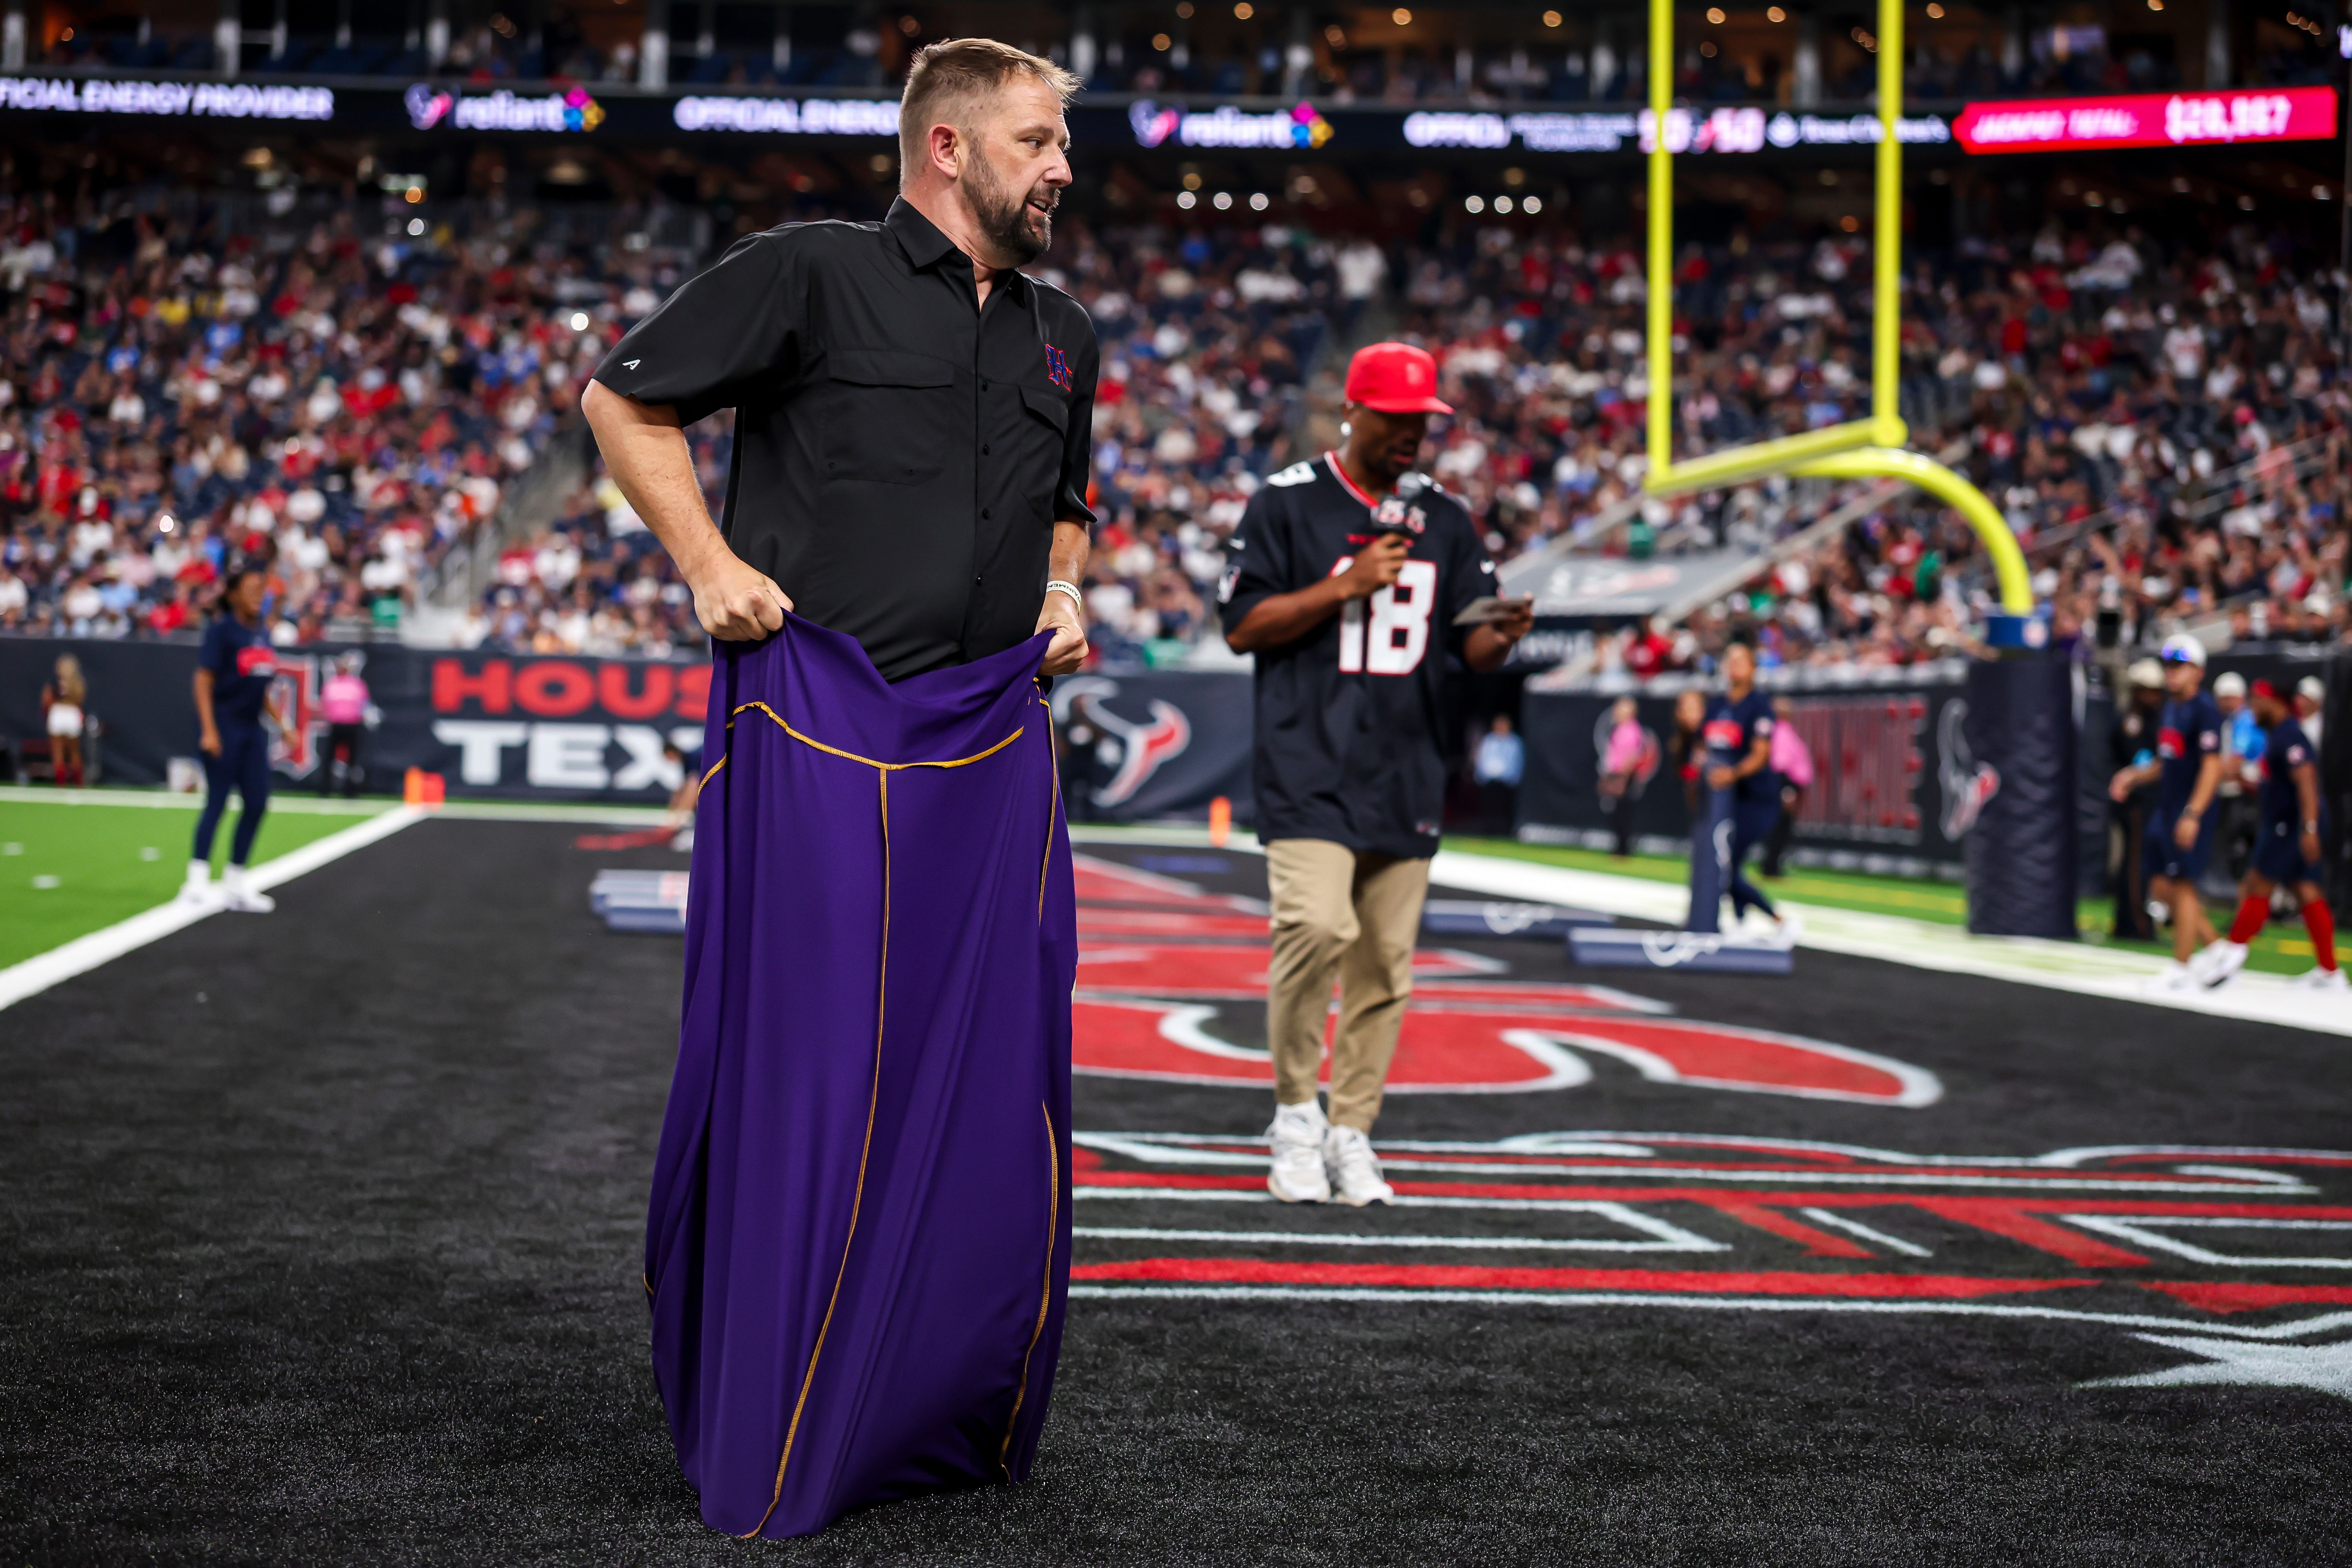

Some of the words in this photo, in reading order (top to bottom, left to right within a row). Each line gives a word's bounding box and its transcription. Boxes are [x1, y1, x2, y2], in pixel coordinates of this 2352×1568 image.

[80, 80, 191, 114] ENERGY
[191, 82, 335, 120] PROVIDER
[455, 88, 566, 131] reliant
[1181, 105, 1292, 147] reliant
[1330, 554, 1438, 677] 18
